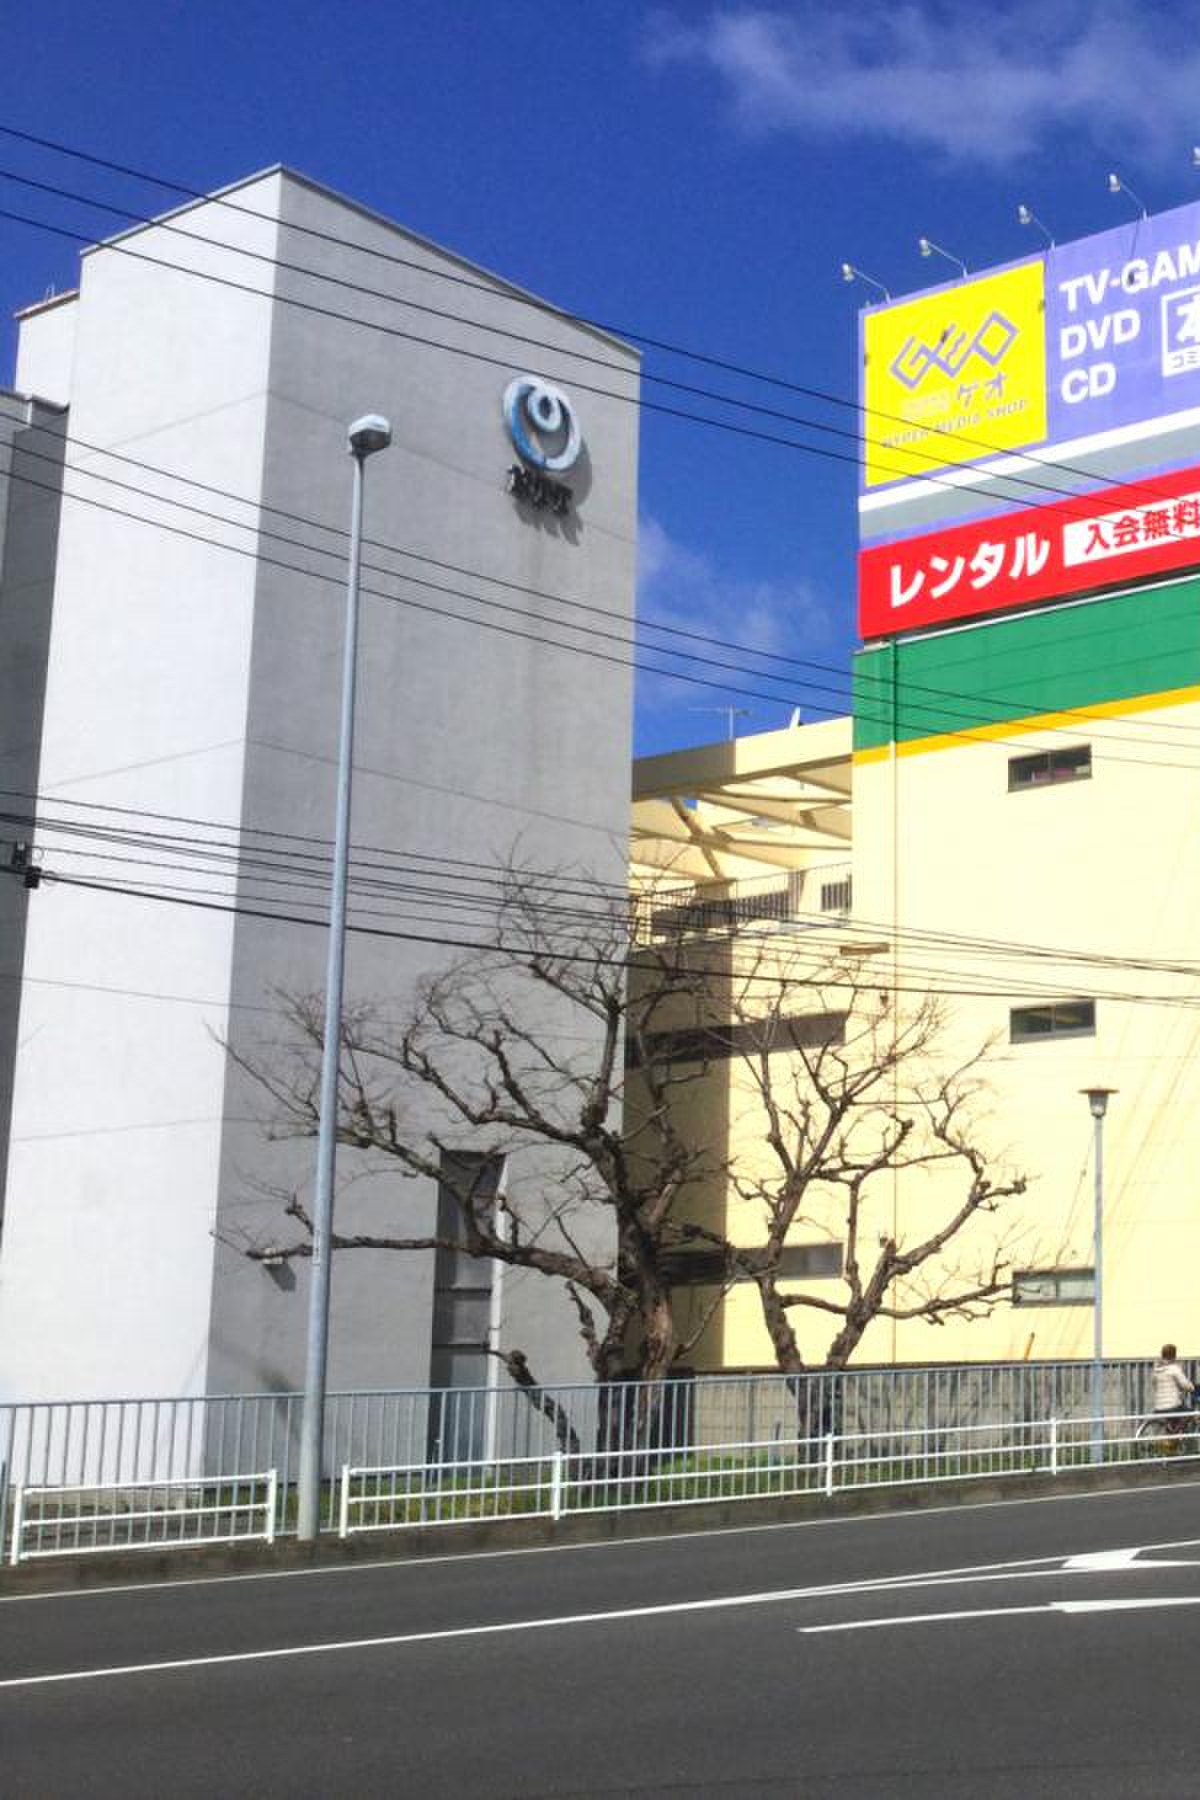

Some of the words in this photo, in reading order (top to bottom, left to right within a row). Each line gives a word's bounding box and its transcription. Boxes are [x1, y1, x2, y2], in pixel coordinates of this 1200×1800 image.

[889, 311, 1020, 391] GEO
[1060, 309, 1140, 361] DVD
[957, 371, 1009, 408] ゲオ
[1061, 363, 1117, 403] CD
[891, 532, 1050, 608] レンタル
